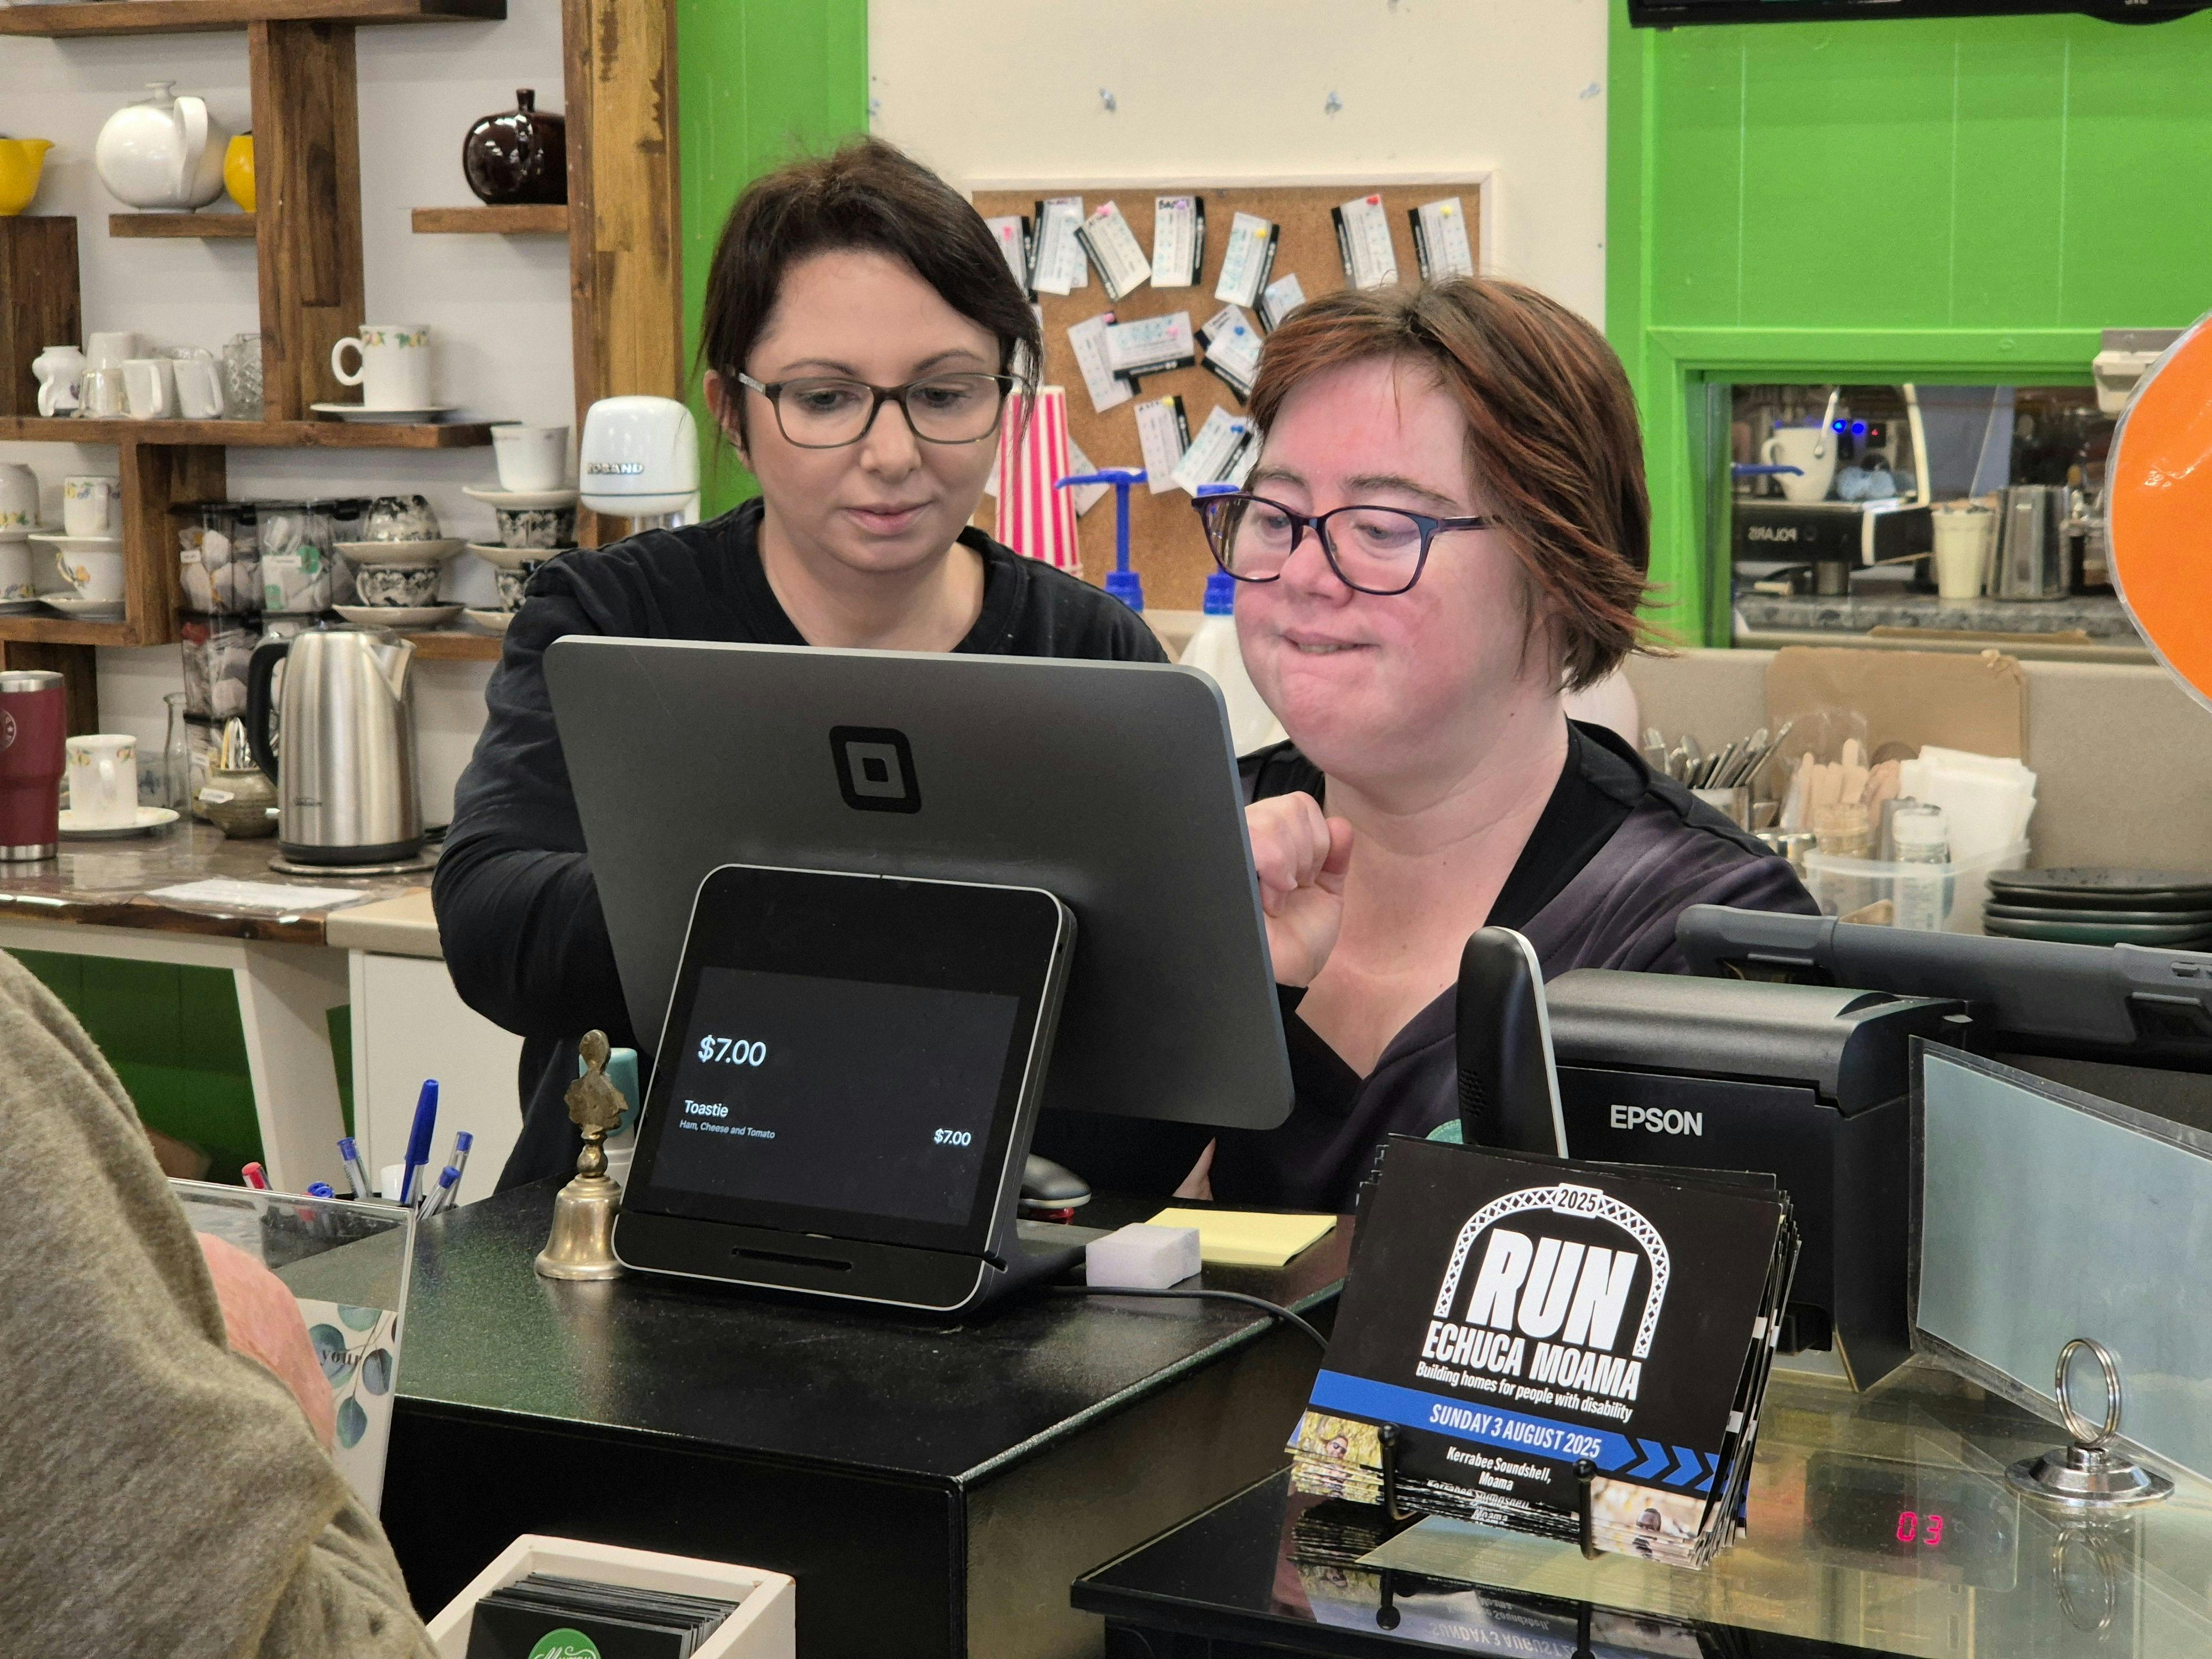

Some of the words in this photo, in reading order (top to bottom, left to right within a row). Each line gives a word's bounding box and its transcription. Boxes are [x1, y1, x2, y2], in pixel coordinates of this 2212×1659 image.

[698, 1034, 766, 1066] $7.00
[685, 1099, 729, 1118] Toastie
[1610, 1104, 1703, 1136] EPSON
[680, 1119, 698, 1131] Ham,
[700, 1121, 729, 1134] Cheese
[730, 1126, 746, 1135] and
[747, 1127, 775, 1139] Tomato
[934, 1128, 972, 1146] $7.00
[1557, 1188, 1597, 1212] 2025
[1465, 1228, 1639, 1351] RUN
[1421, 1319, 1525, 1376] ECHUCA
[1528, 1342, 1642, 1401] MOAMA
[1416, 1361, 1460, 1387] Building
[1460, 1370, 1498, 1392] homes
[1498, 1378, 1517, 1396] for
[1514, 1385, 1553, 1405] people
[1554, 1392, 1580, 1410] with
[1580, 1397, 1634, 1424] disability
[1430, 1404, 1493, 1434] SUNDAY
[1490, 1417, 1503, 1437] 3
[1502, 1420, 1565, 1451] AUGUST
[1562, 1433, 1603, 1458] 2025
[1446, 1446, 1494, 1470] Kerrabee
[1494, 1457, 1552, 1484] Soundshell,
[1478, 1471, 1514, 1491] Moama
[1896, 1511, 1943, 1545] 03
